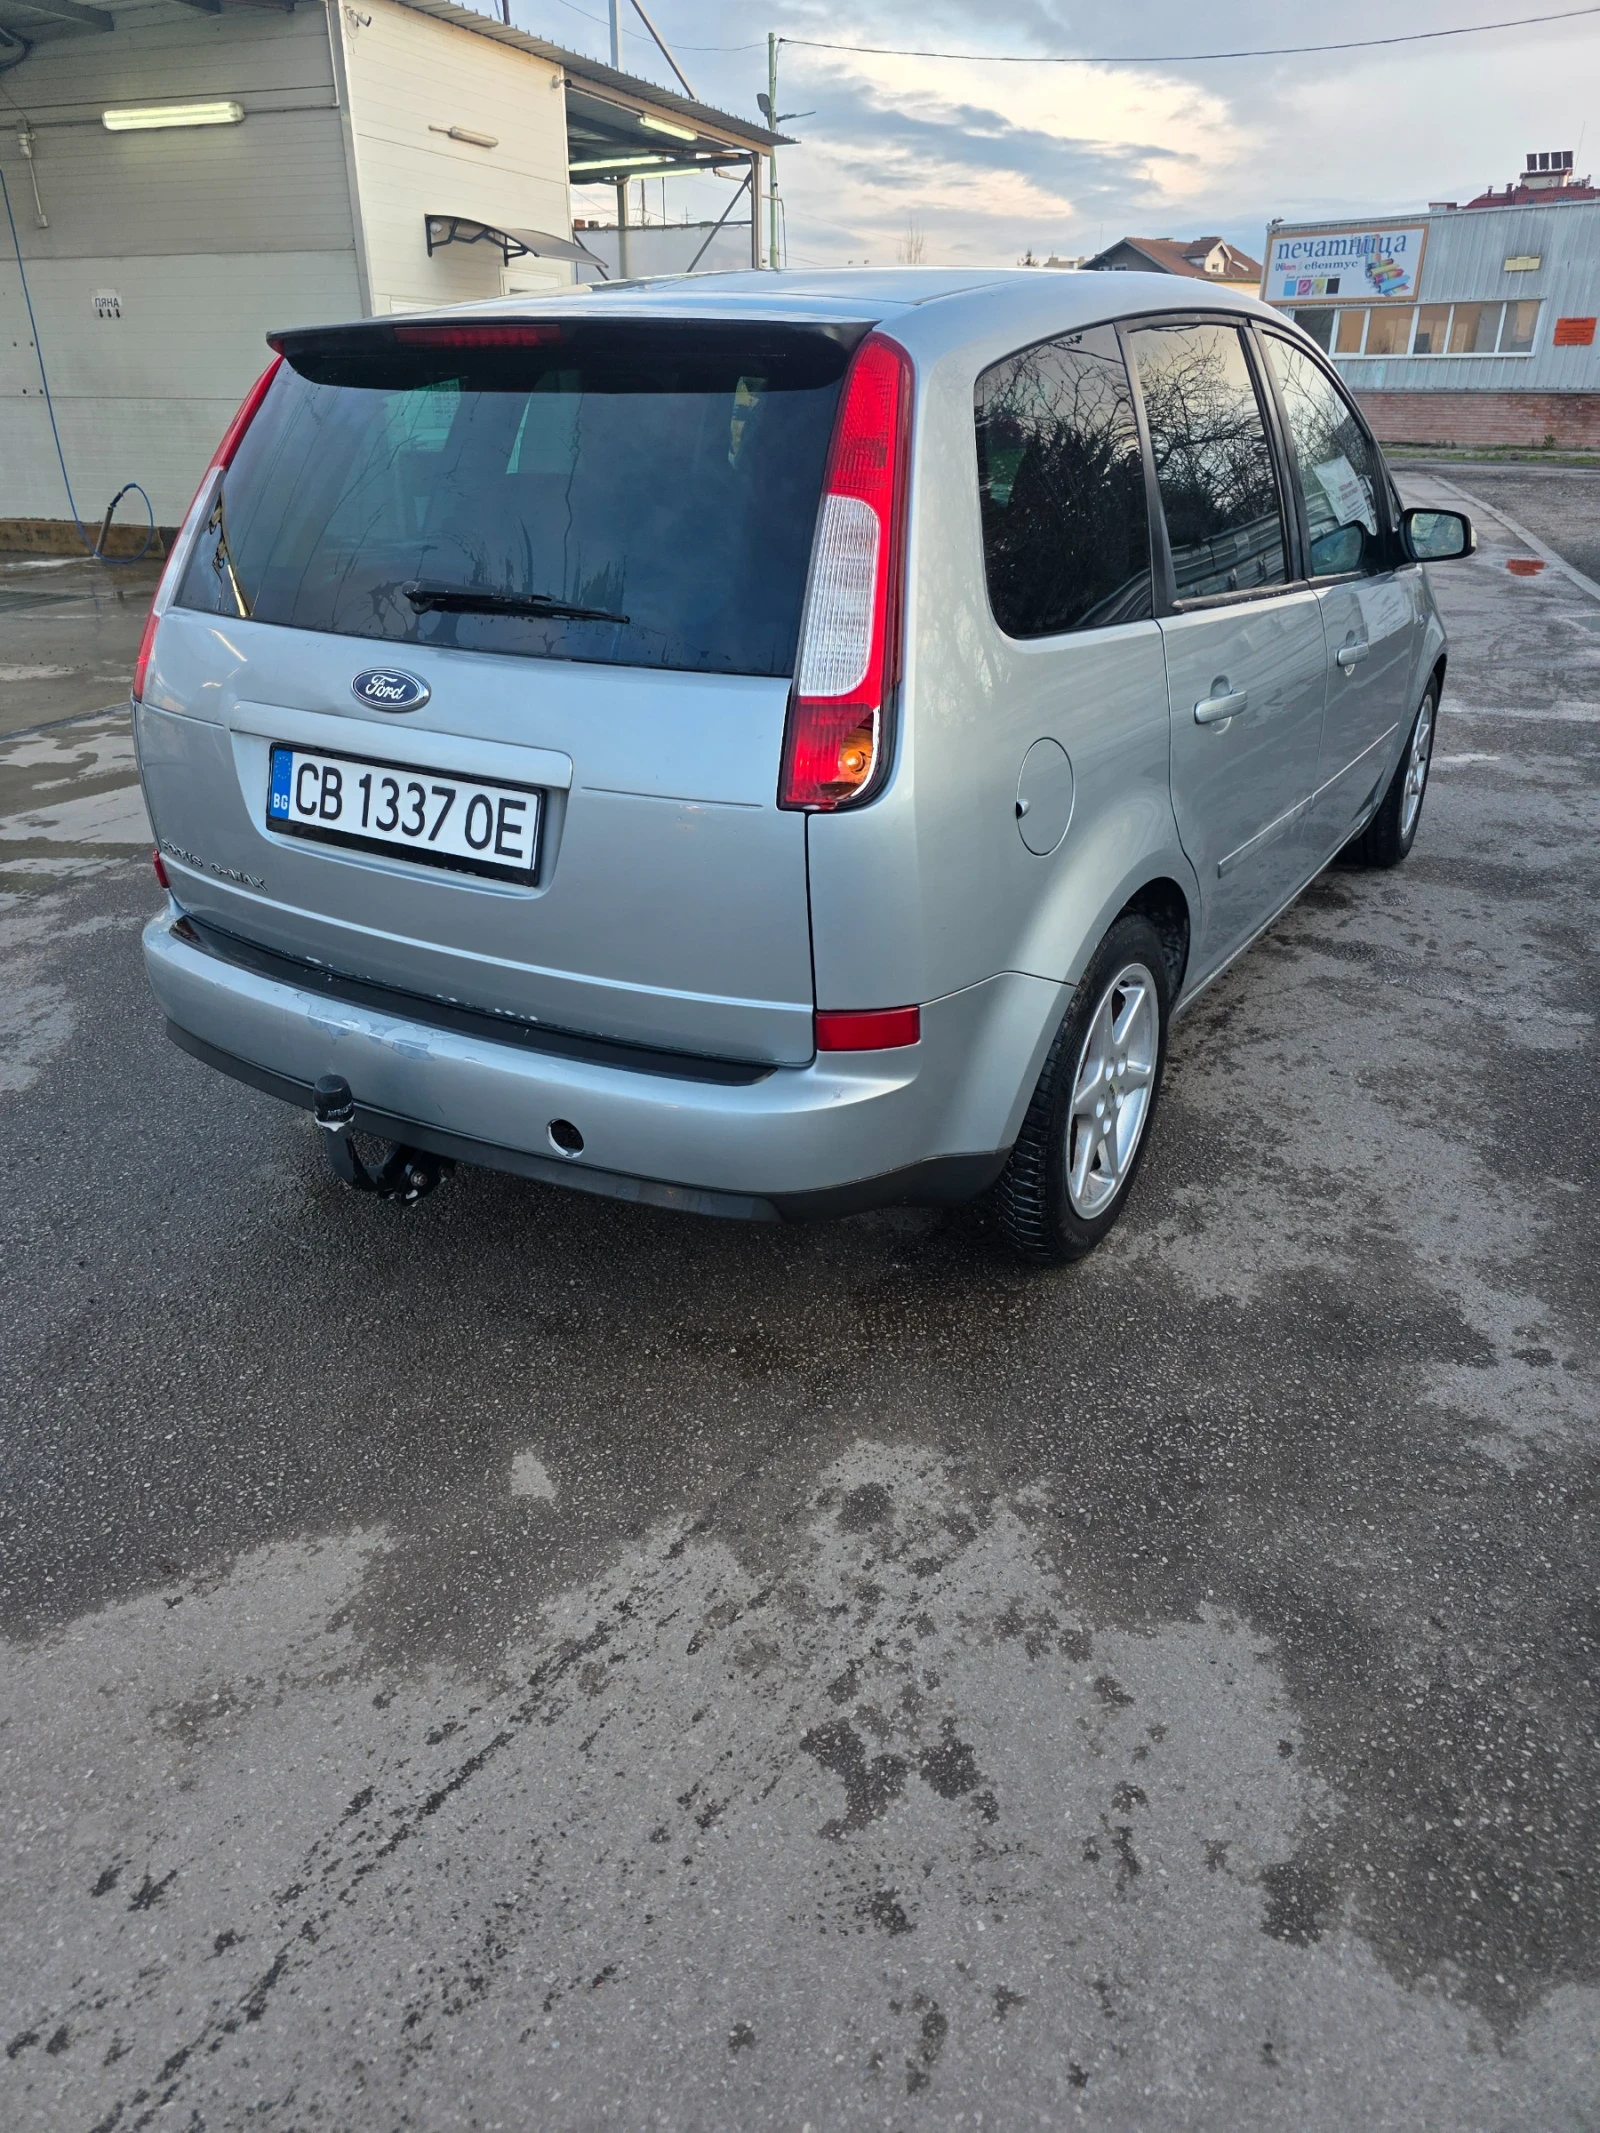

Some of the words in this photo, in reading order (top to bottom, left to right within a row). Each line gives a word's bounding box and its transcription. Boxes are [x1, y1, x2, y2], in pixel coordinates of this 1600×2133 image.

[1277, 235, 1407, 260] печатница
[95, 298, 119, 307] ПЯНА
[365, 674, 407, 700] Ford
[273, 793, 289, 810] BG
[359, 774, 456, 841] 1337
